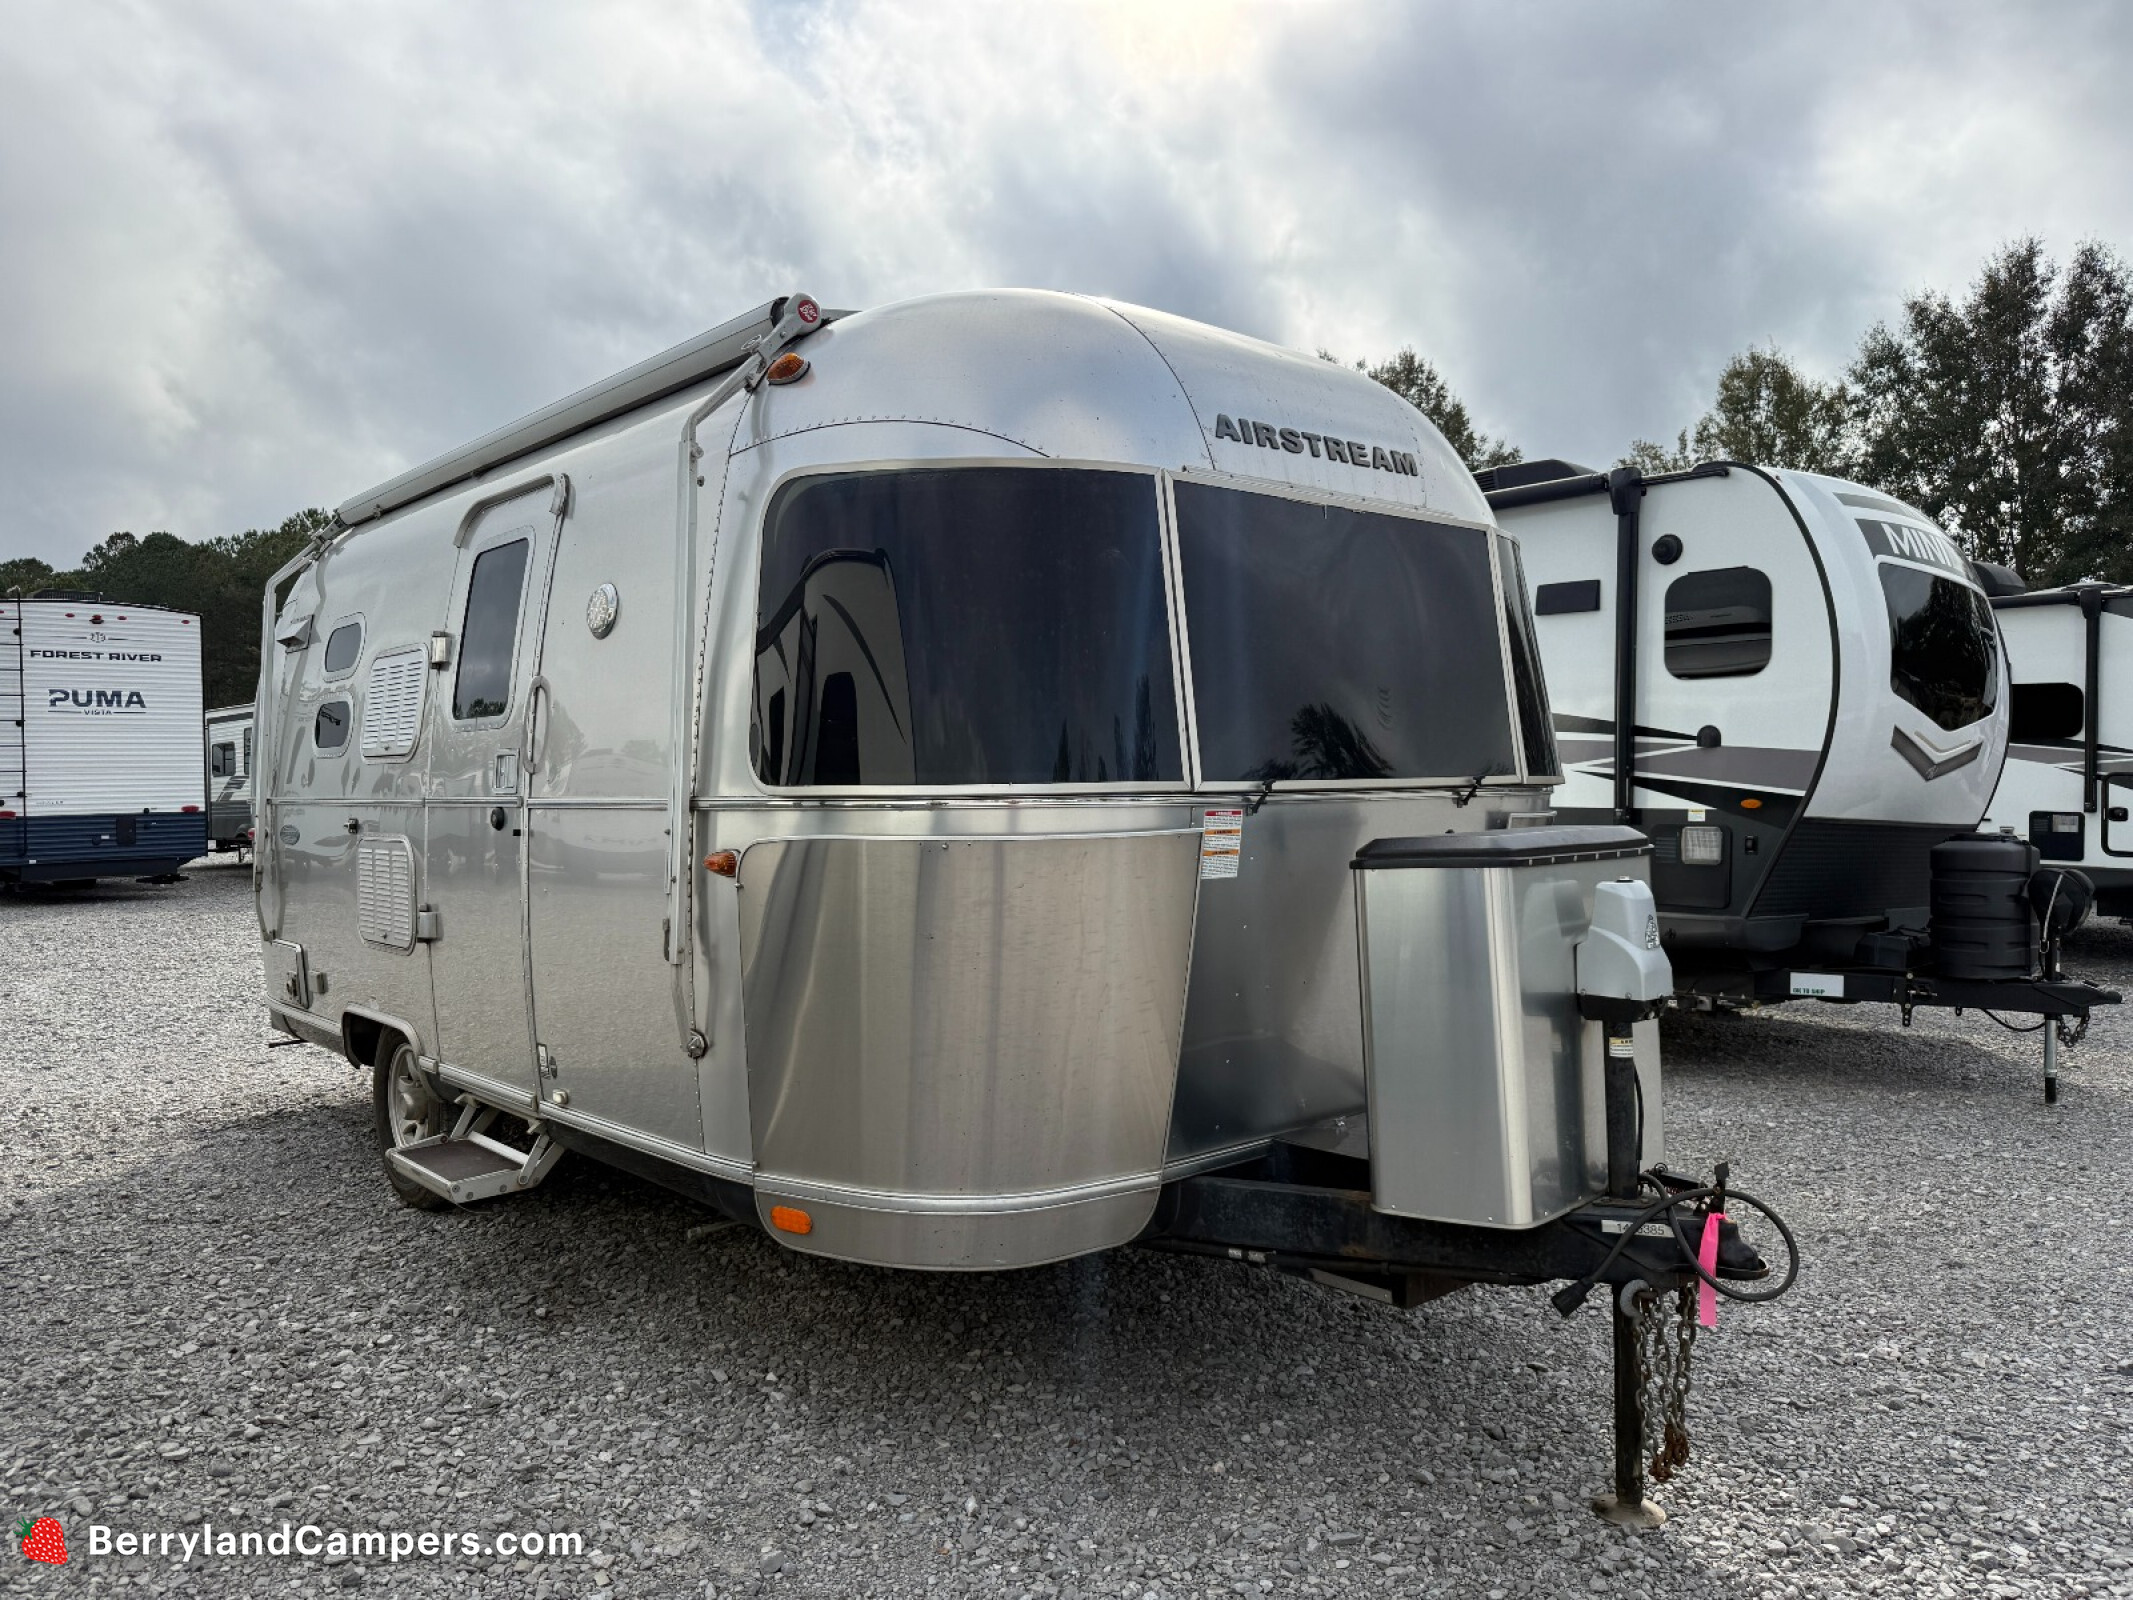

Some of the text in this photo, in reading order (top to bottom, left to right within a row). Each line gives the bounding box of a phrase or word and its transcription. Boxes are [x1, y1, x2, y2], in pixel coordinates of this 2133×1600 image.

[1215, 413, 1419, 476] AIRSTREAM
[30, 650, 162, 662] FOREST RIVER
[48, 688, 147, 708] PUMA
[83, 708, 113, 716] VISTA
